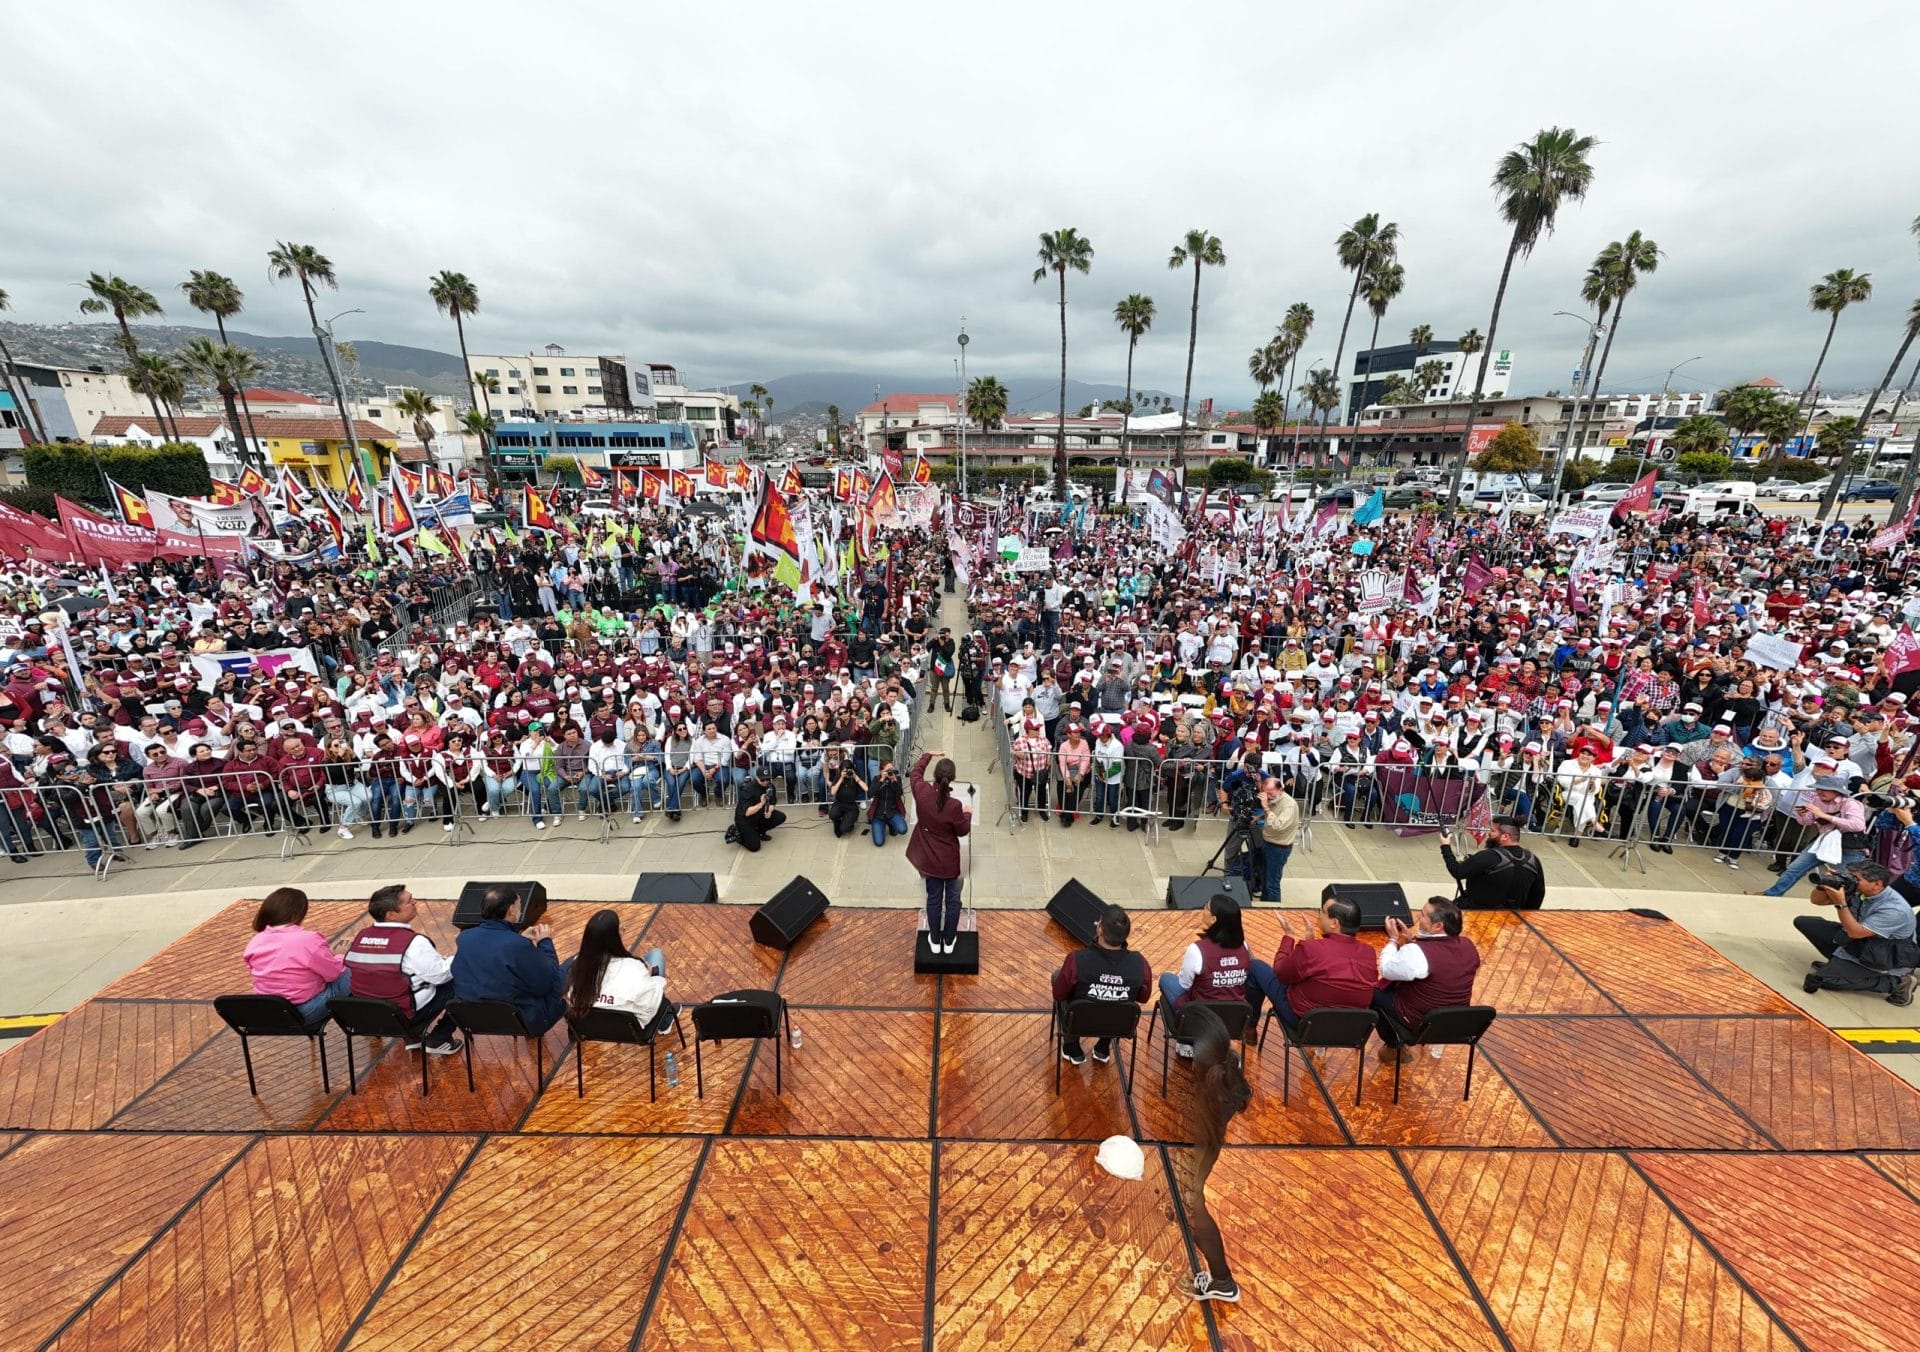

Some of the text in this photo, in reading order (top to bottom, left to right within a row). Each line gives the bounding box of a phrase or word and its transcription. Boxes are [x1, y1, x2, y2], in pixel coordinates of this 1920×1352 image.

[673, 476, 694, 497] PT
[840, 477, 850, 494] P
[529, 493, 545, 521] P
[216, 521, 247, 529] VOTA
[1099, 975, 1123, 984] VOTA
[1089, 983, 1130, 991] ARMANDO
[1088, 988, 1128, 998] AYALA
